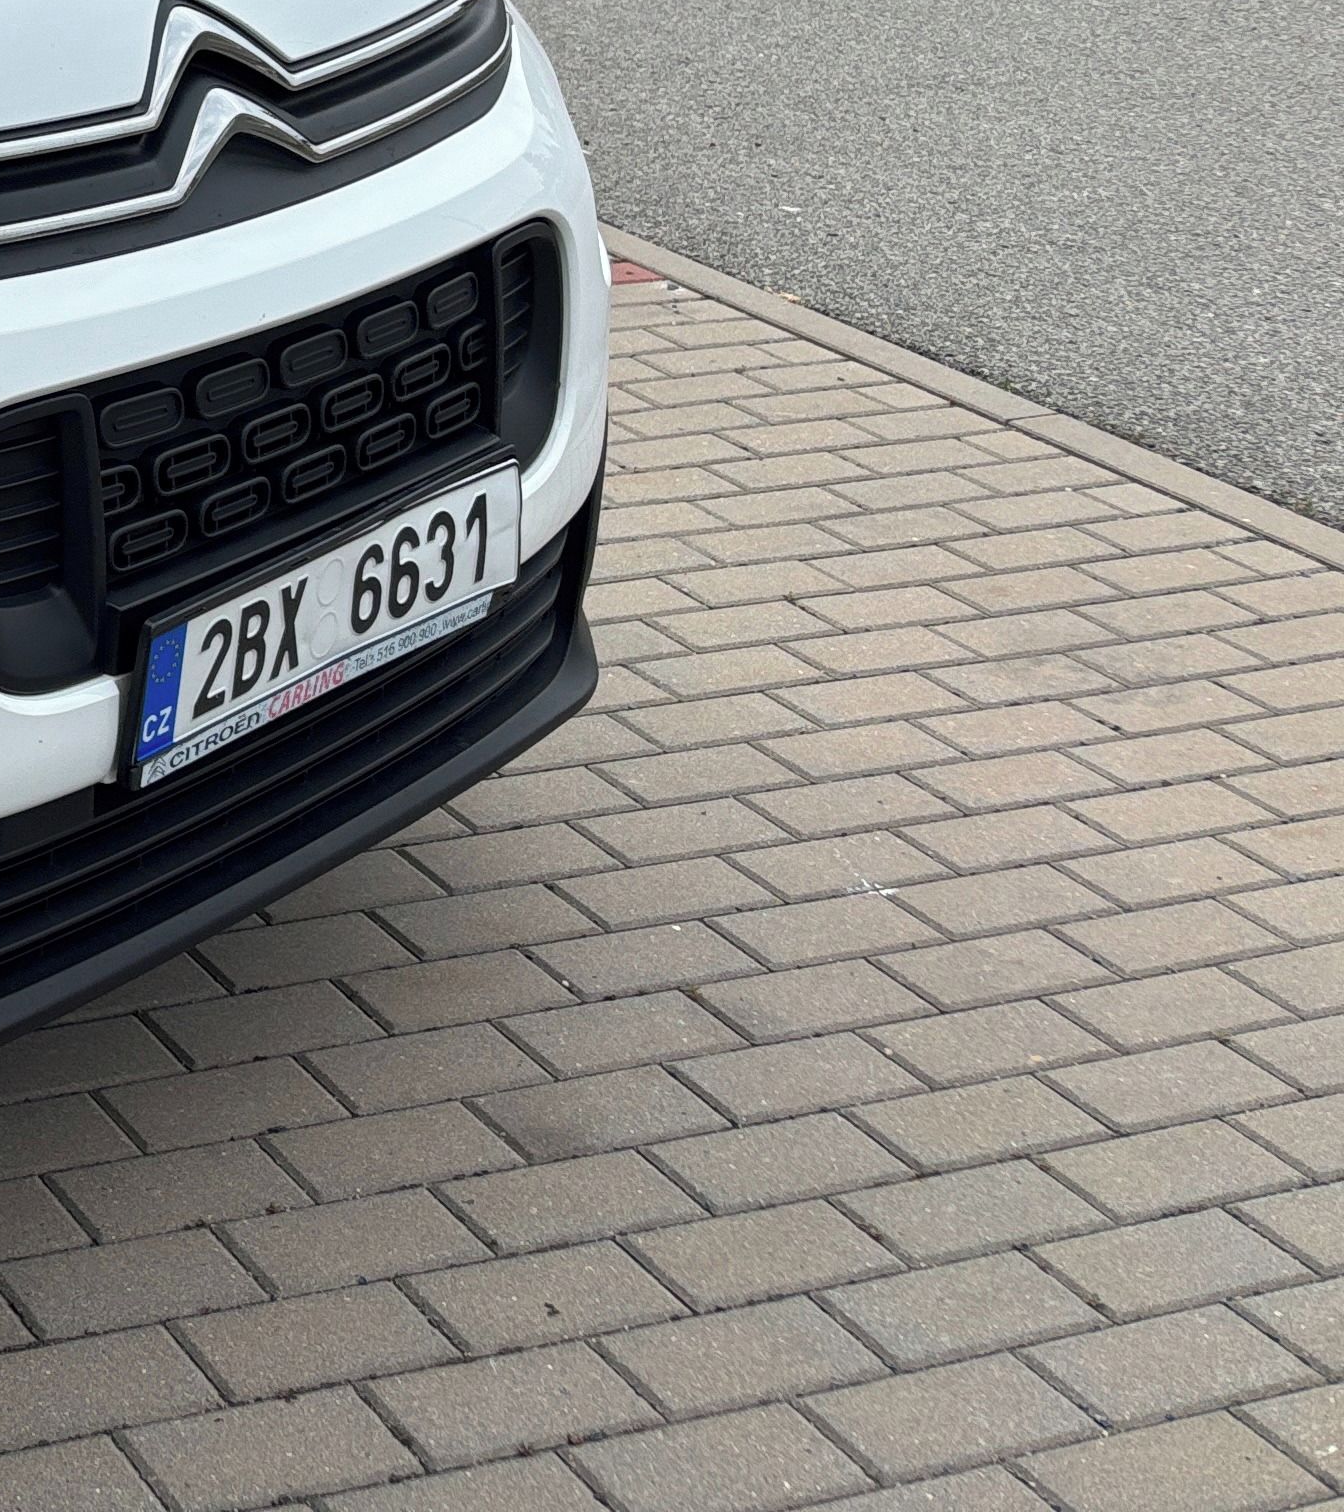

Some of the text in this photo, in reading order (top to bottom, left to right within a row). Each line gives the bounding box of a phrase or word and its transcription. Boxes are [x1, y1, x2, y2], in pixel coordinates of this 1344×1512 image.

[192, 492, 488, 721] 2BX 6631
[267, 662, 345, 719] CARLING
[141, 706, 173, 744] CZ
